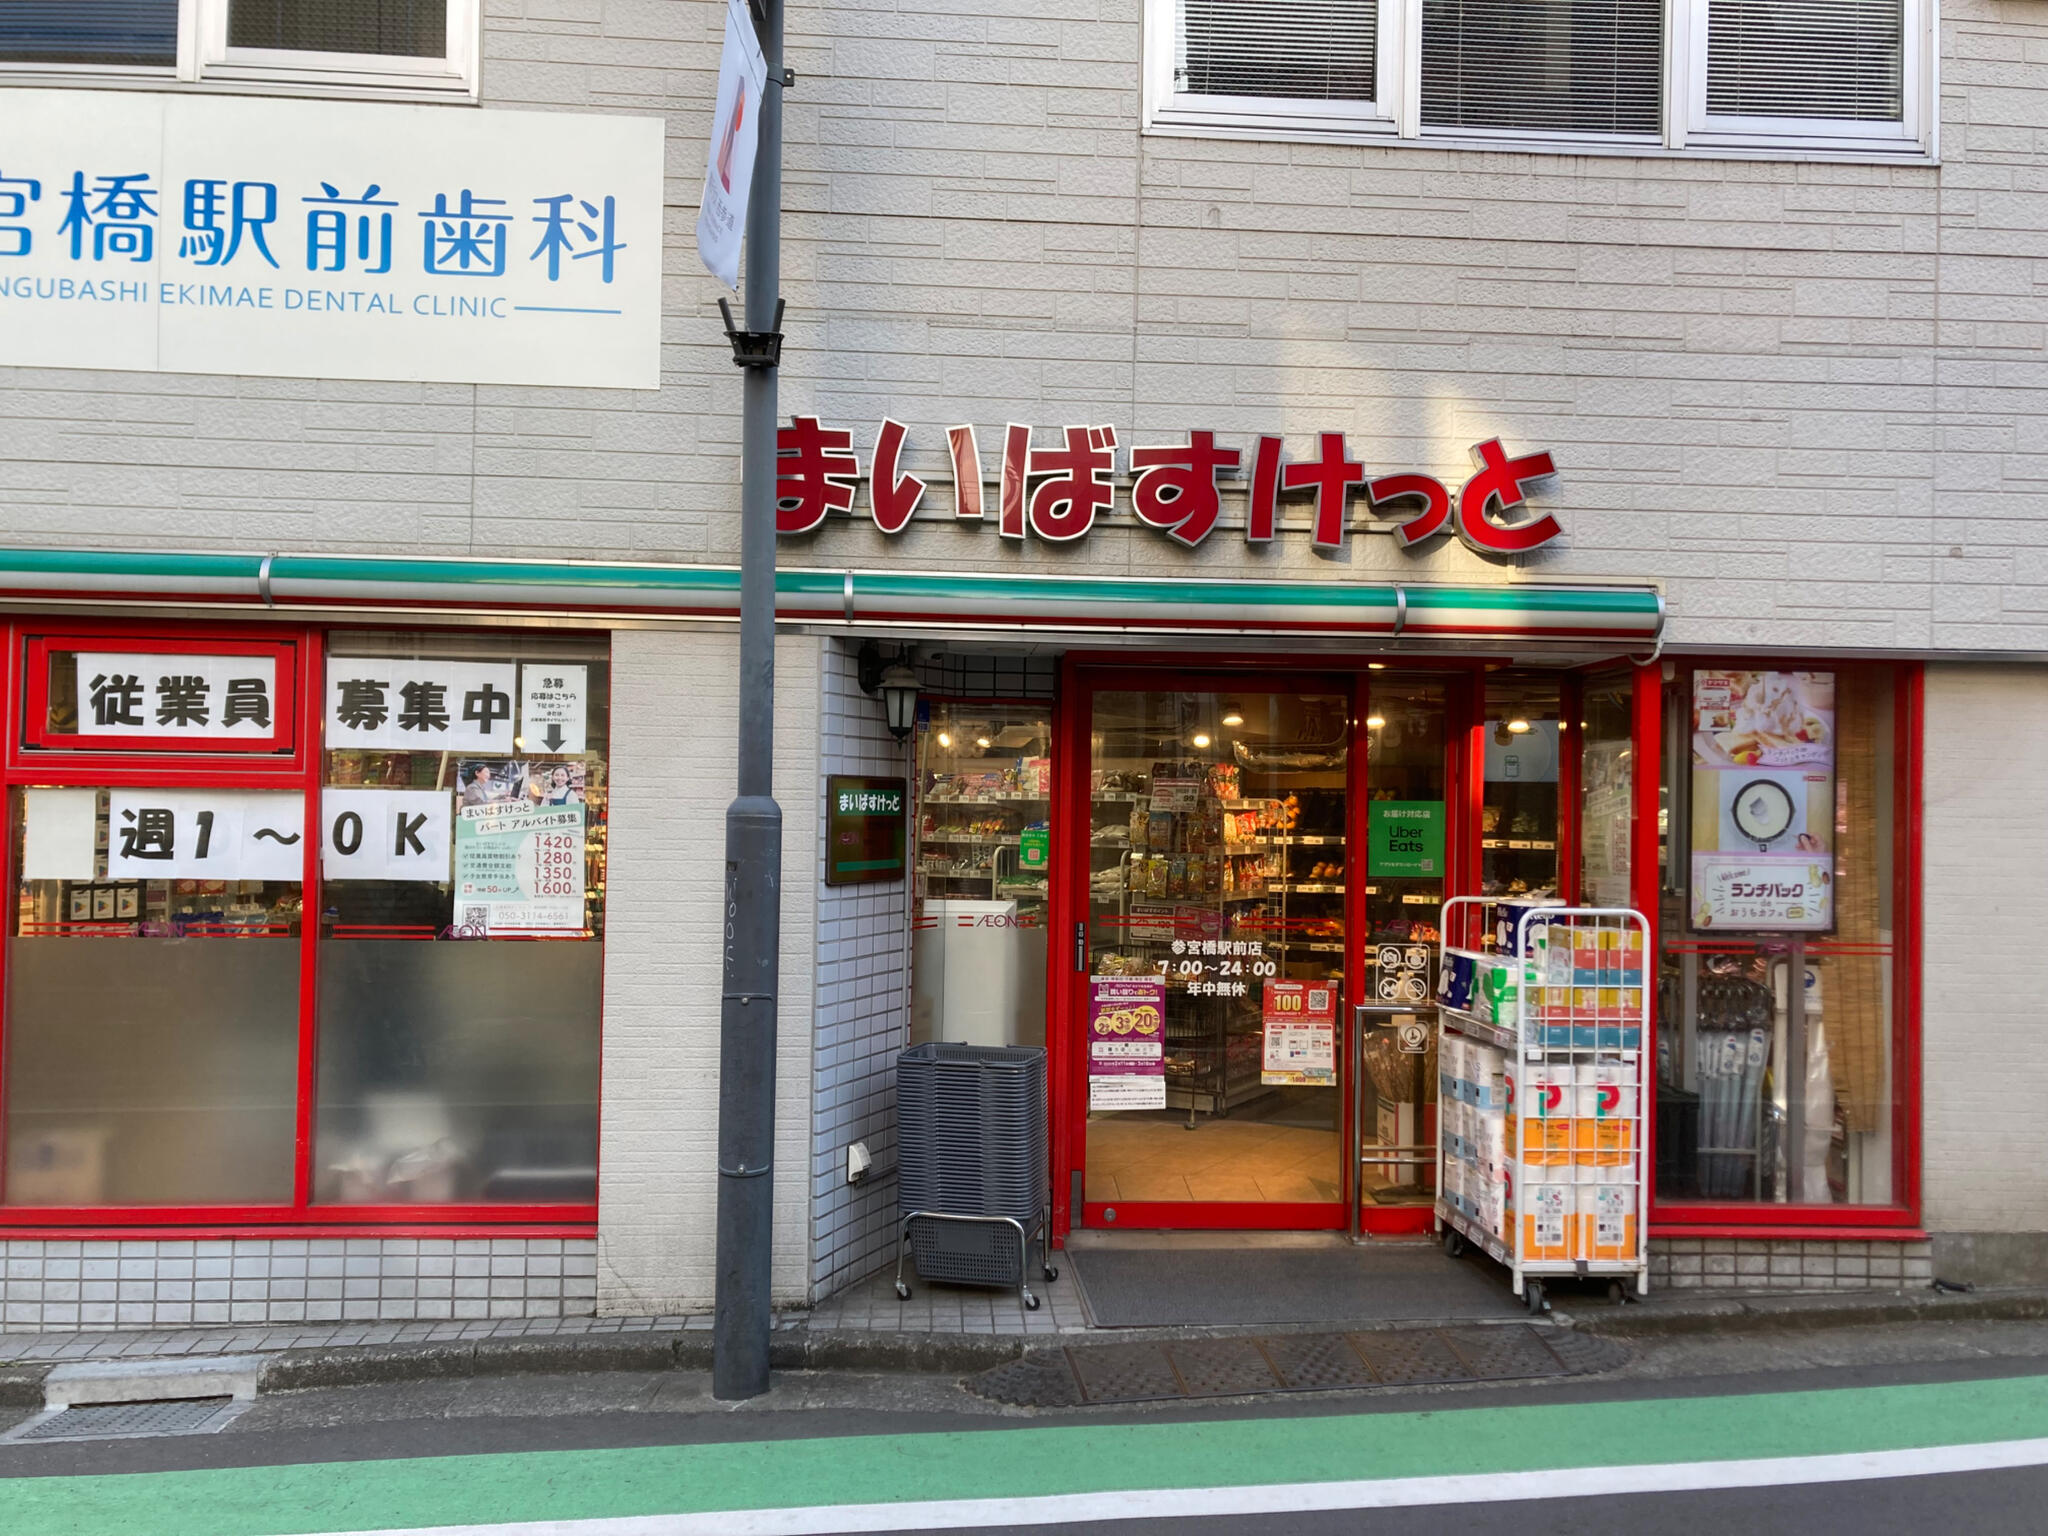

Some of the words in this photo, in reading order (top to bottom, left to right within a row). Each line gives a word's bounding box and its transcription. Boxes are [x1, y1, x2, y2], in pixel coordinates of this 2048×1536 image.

[160, 282, 273, 309] EKIMAE
[284, 289, 403, 315] DENTAL
[413, 294, 508, 319] CLINIC
[777, 414, 1565, 557] まいばすけっと
[90, 674, 272, 727] 従業員
[337, 679, 511, 734] 募集中
[839, 793, 900, 812] まいばすけっと
[466, 803, 530, 818] まいばすけっと
[1389, 825, 1424, 838] Uber
[535, 836, 573, 848] 1420
[1389, 839, 1424, 852] Eats
[535, 852, 573, 864] 1280
[534, 867, 572, 879] 1350
[534, 882, 572, 894] 1600
[1171, 940, 1263, 956] 参宮橋駅前店
[1187, 982, 1246, 997] 年中無休
[1274, 995, 1302, 1011] 100
